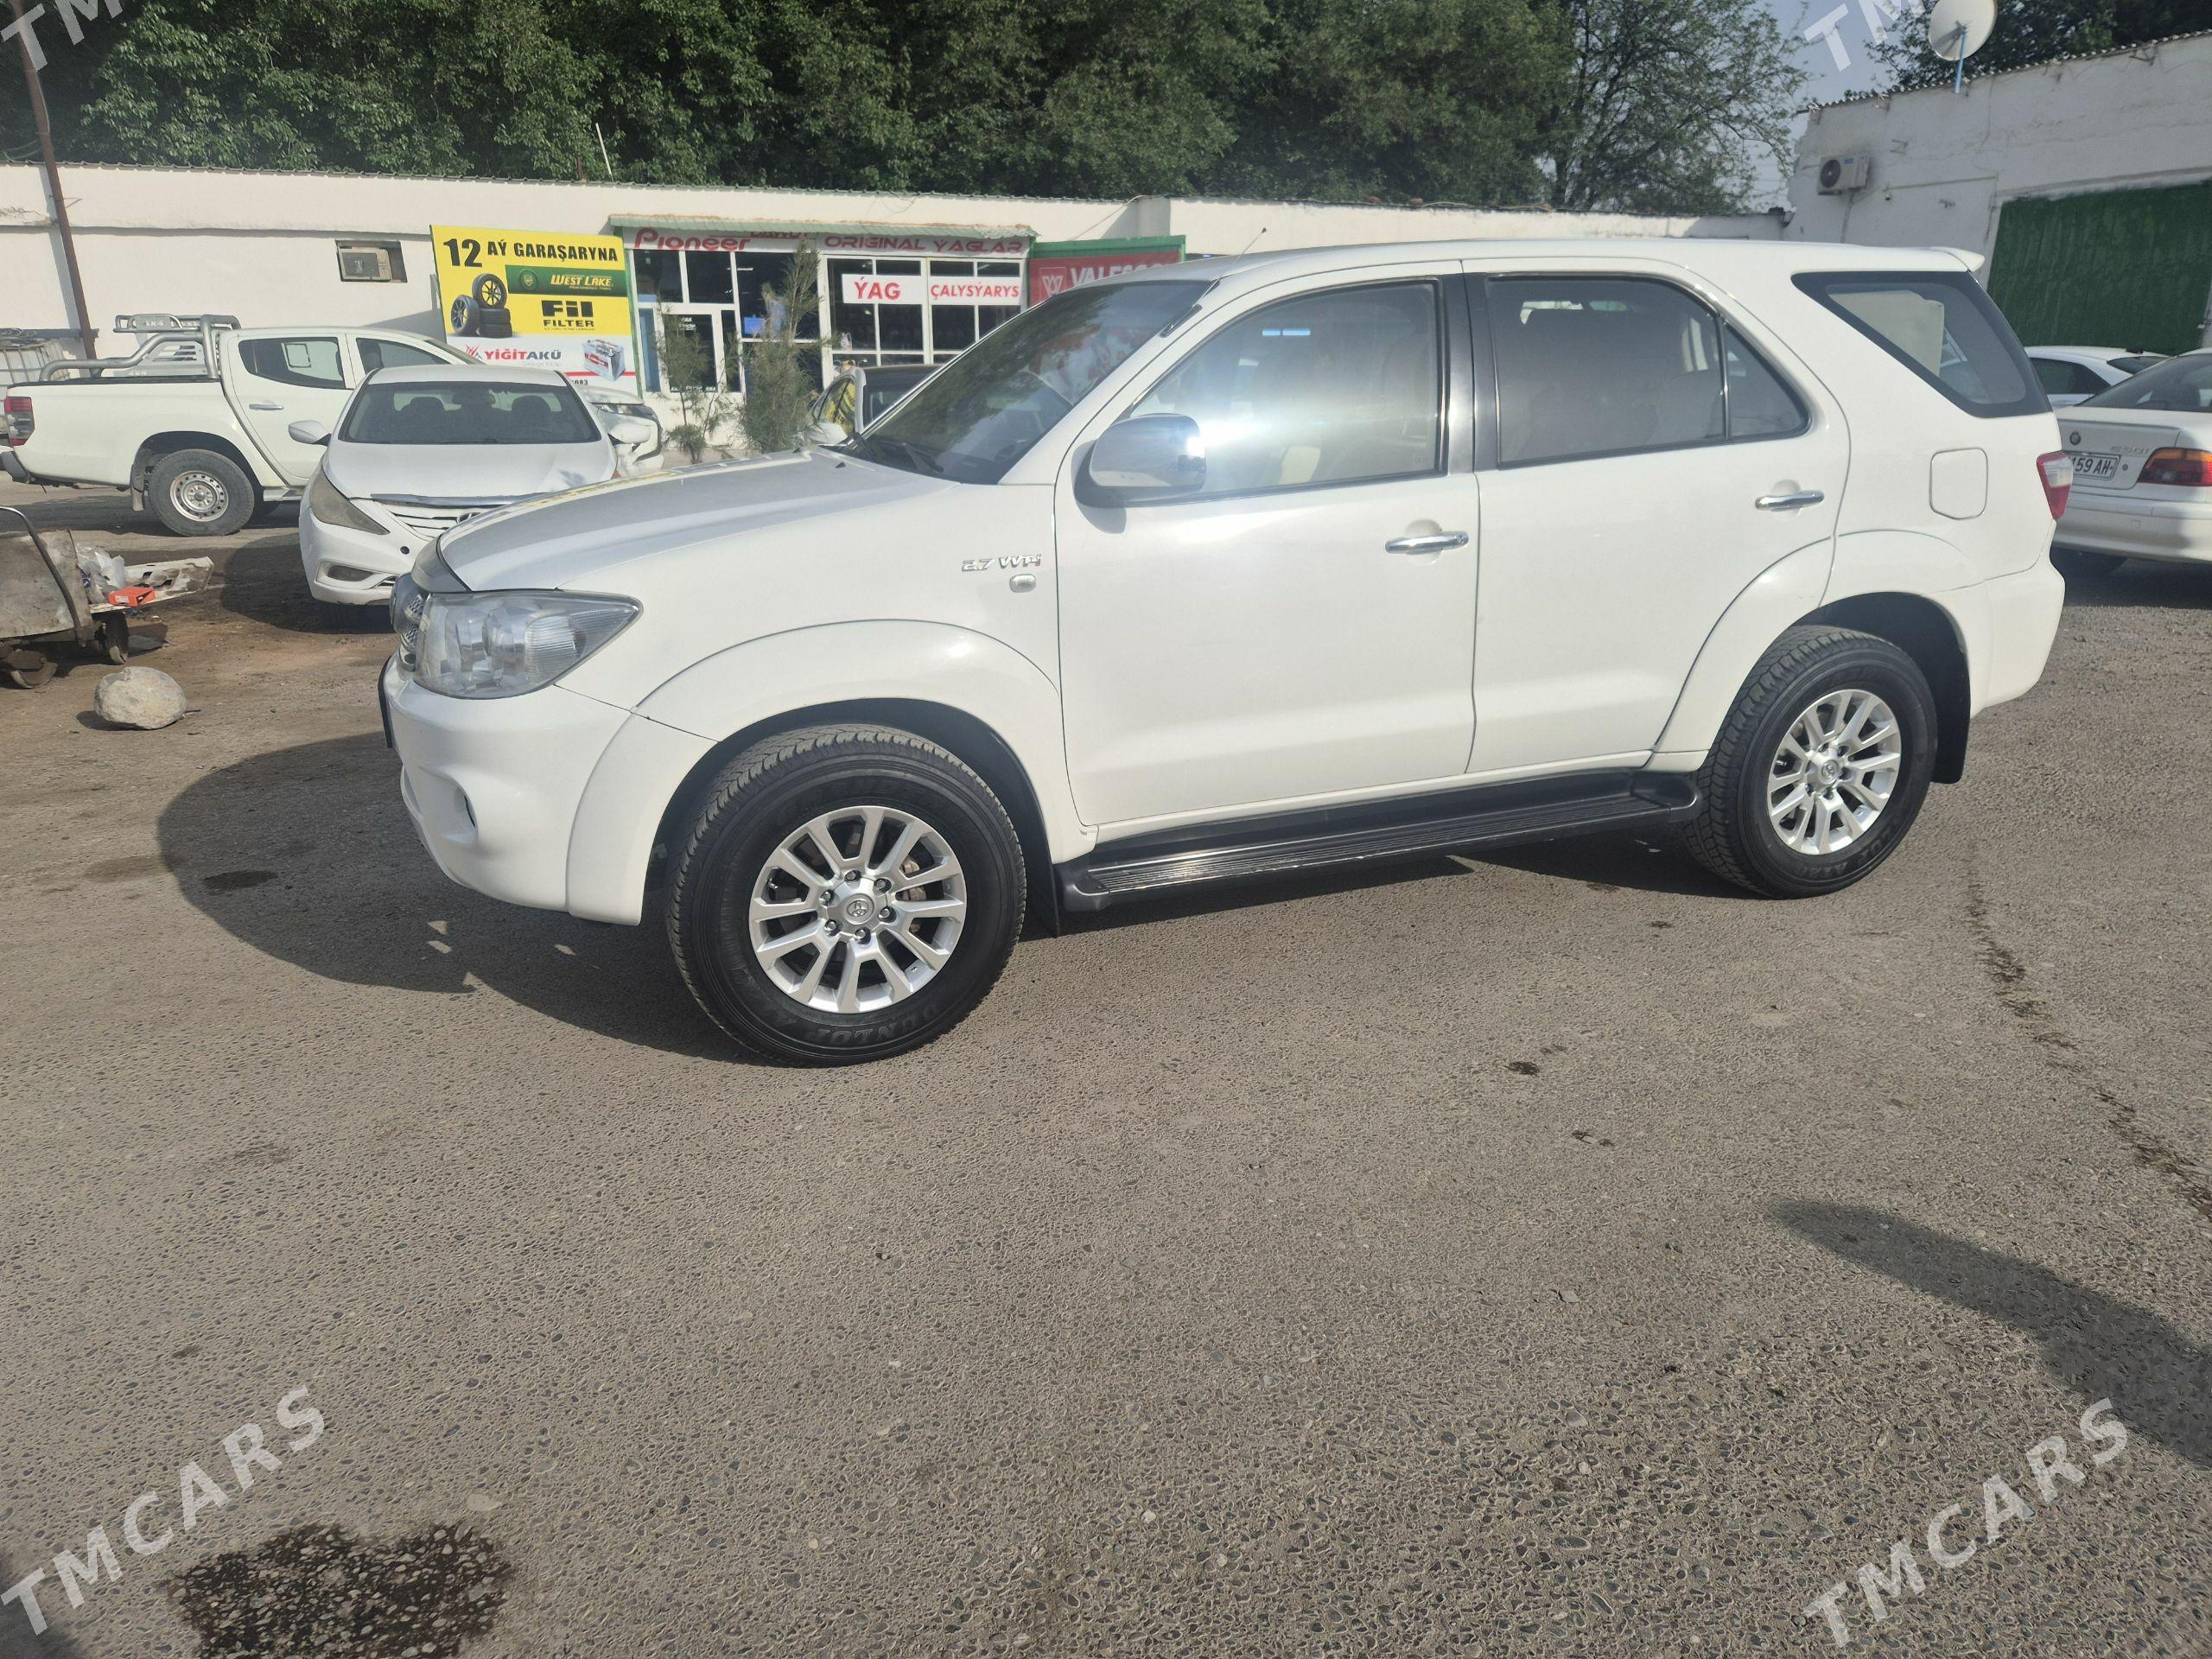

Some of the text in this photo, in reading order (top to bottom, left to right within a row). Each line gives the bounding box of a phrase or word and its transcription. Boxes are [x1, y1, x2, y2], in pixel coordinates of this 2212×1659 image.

[634, 227, 751, 251] Pioneer
[824, 236, 925, 250] ORIGINAL
[443, 238, 618, 267] 12 AÝ GARAŞARYNA
[550, 275, 613, 287] WEST LAKE
[854, 276, 900, 300] ÝAG
[931, 281, 1020, 299] ÇALYSÝARYS
[962, 558, 995, 572] 2.7
